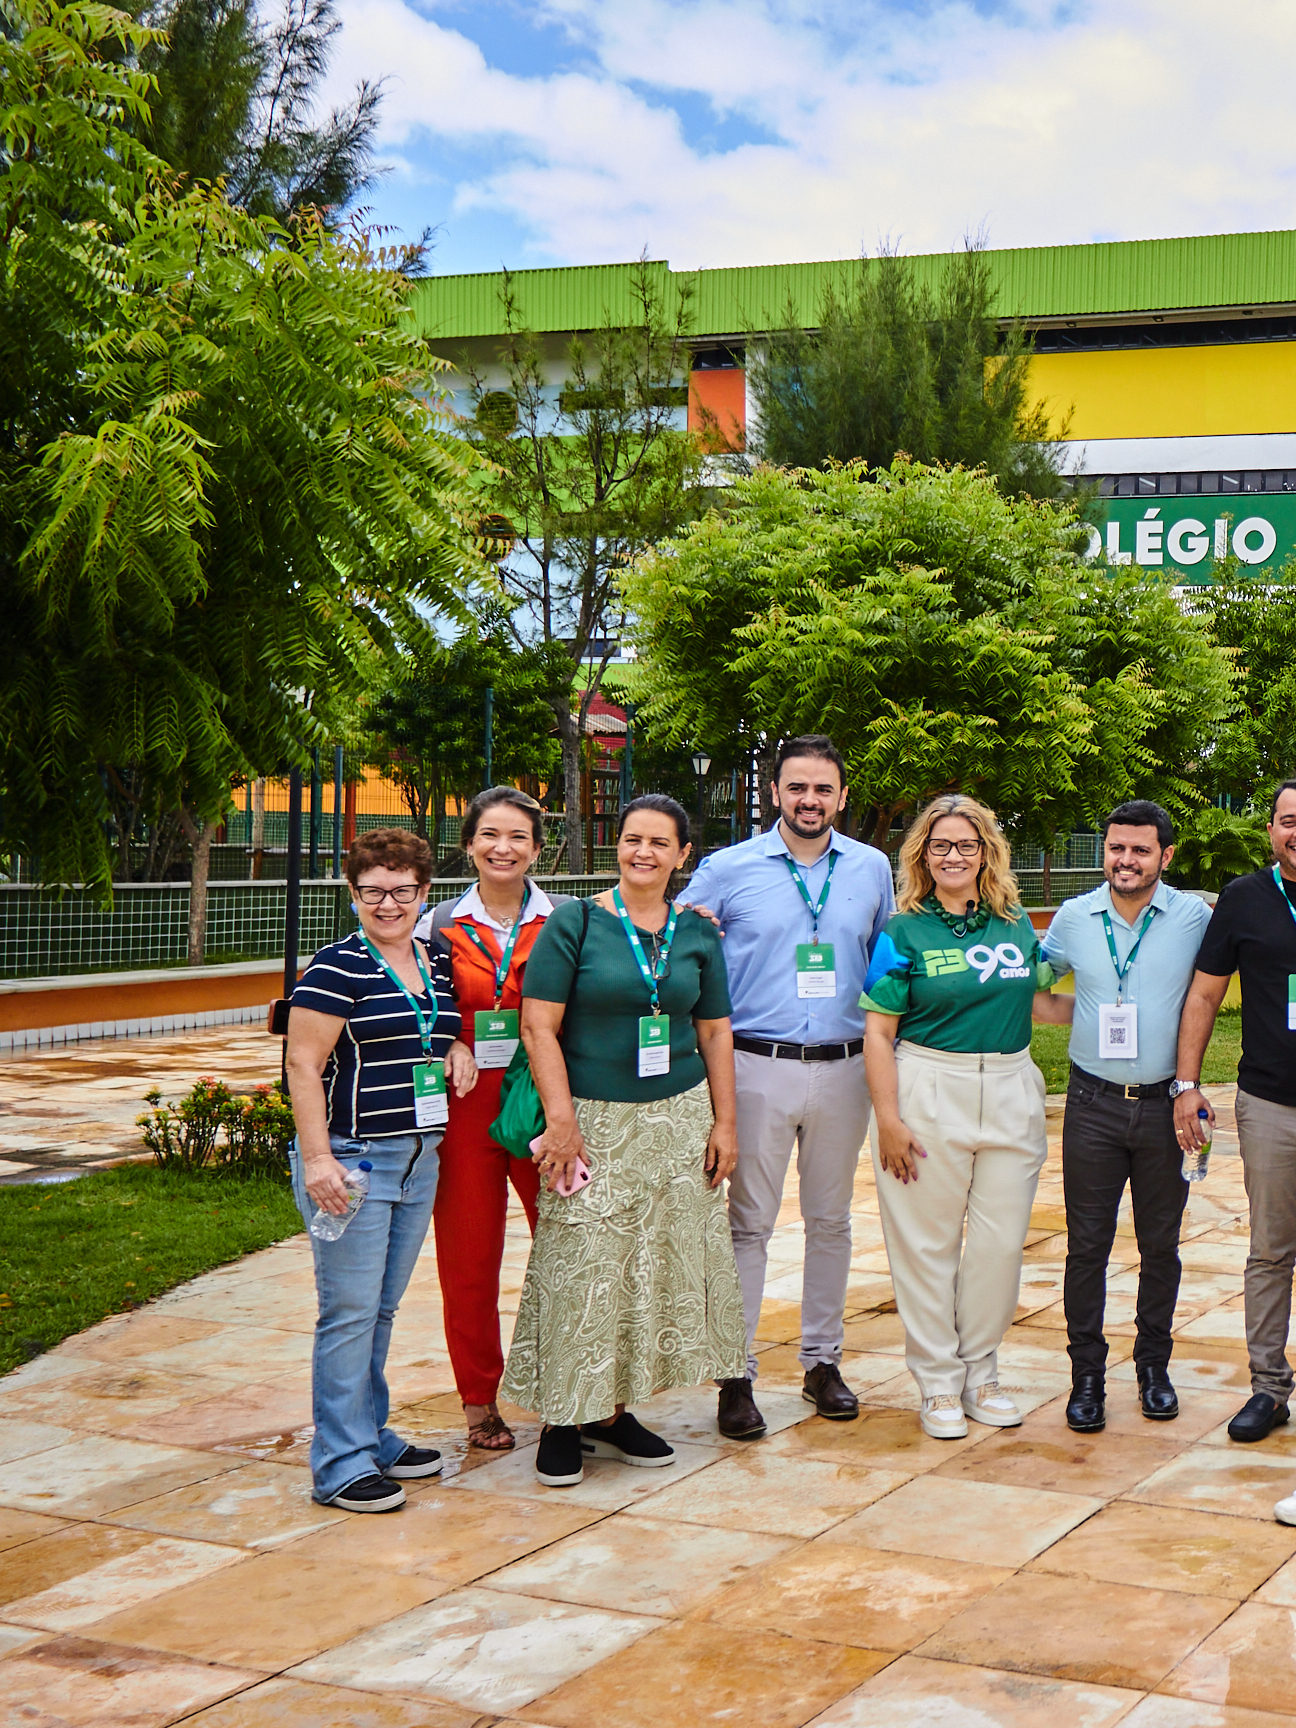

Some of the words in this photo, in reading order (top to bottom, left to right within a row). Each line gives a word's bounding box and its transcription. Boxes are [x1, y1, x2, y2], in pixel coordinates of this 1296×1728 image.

[1066, 508, 1277, 567] OLÉGIO
[965, 943, 1024, 984] 90
[999, 967, 1030, 979] anos
